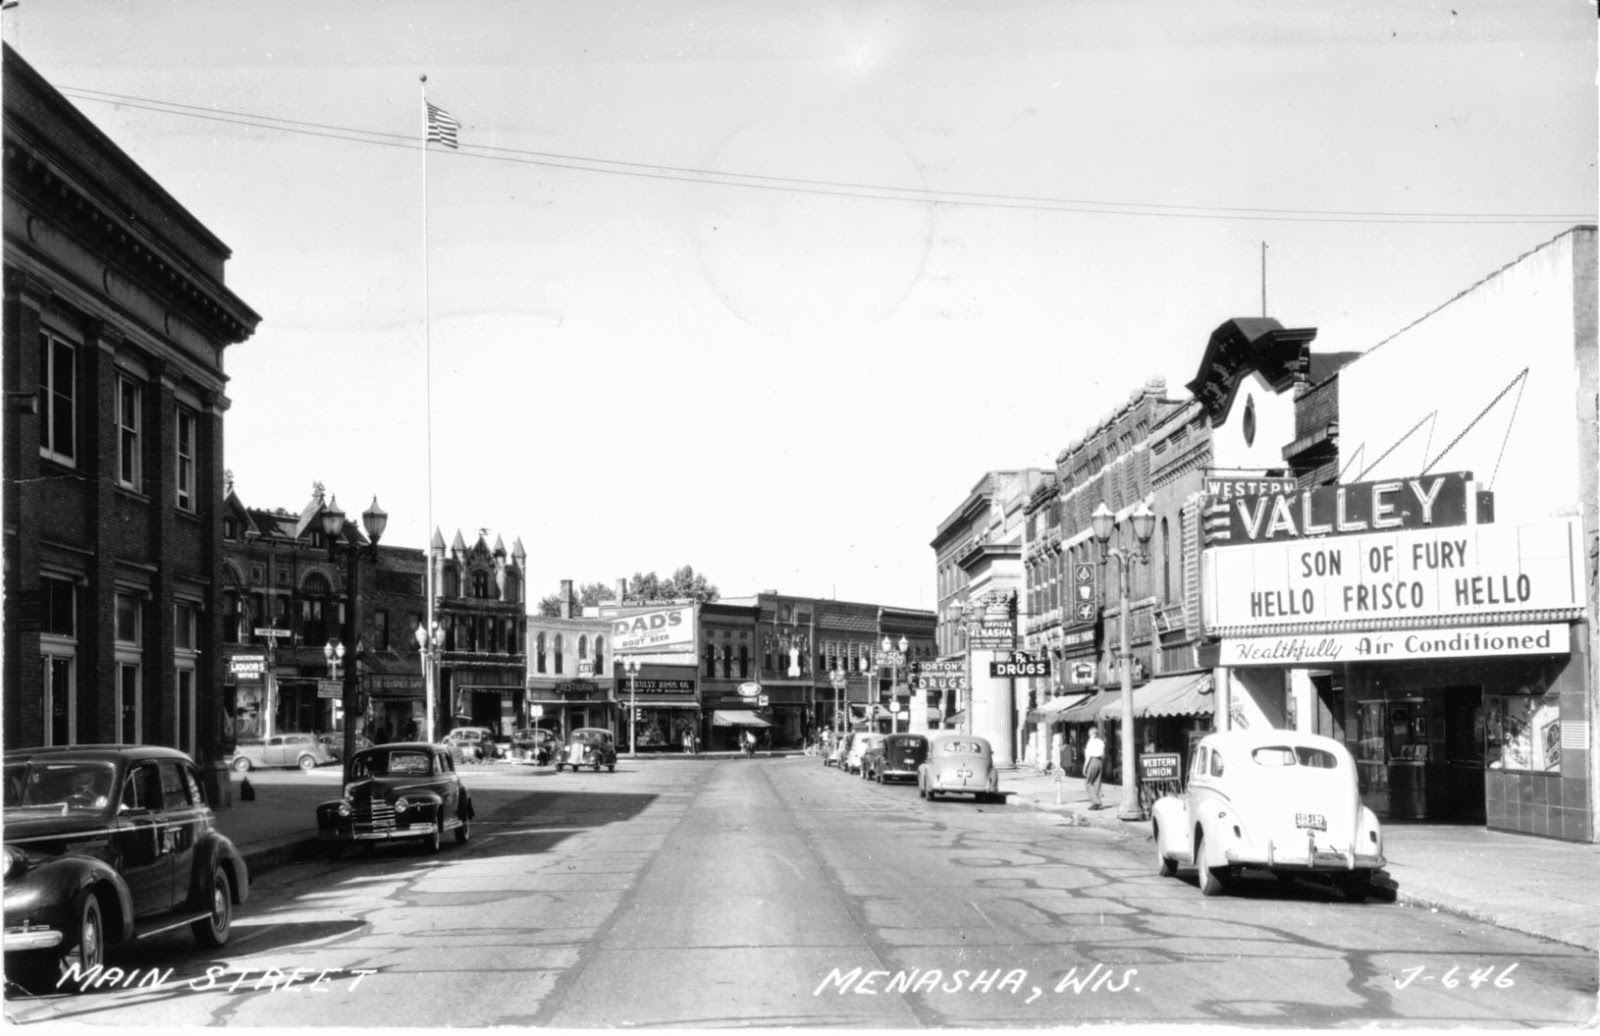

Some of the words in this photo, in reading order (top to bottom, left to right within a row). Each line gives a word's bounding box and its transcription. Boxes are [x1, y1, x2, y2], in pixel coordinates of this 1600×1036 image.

[1208, 480, 1295, 497] WESTERN
[1236, 477, 1446, 540] VALLEY
[1301, 549, 1342, 578] SON
[1369, 545, 1394, 574] OF
[1412, 539, 1468, 571] FURY
[1251, 588, 1315, 618] HELLO
[1343, 581, 1424, 613] FRISCO
[1455, 573, 1532, 607] HELLO
[614, 611, 682, 636] DAD'S
[622, 638, 645, 647] ROOT
[650, 634, 670, 643] BEER
[1236, 638, 1343, 662] Healthfully
[1355, 636, 1394, 656] Air
[1404, 629, 1551, 654] Conditioned
[230, 662, 265, 673] LIQUORS
[996, 663, 1046, 675] DRUGS
[624, 680, 655, 689] SHULTZ
[918, 677, 966, 689] DRUGS
[1143, 758, 1176, 767] WESTERN
[1146, 767, 1172, 777] UNION
